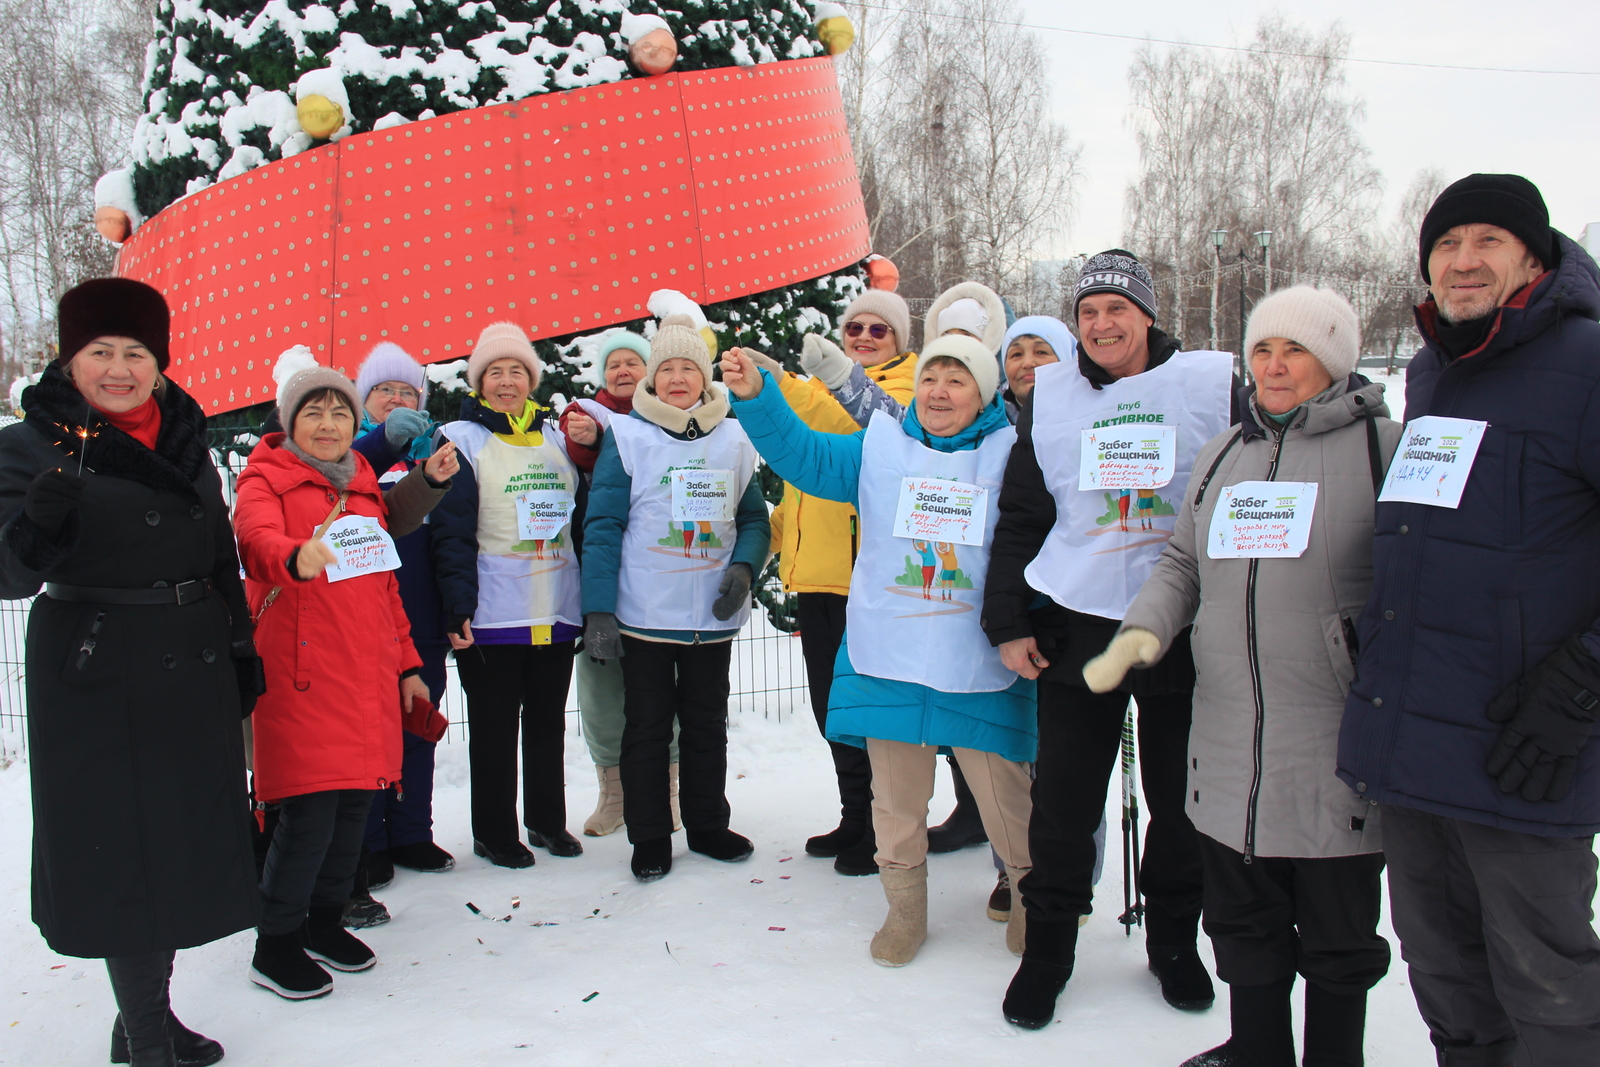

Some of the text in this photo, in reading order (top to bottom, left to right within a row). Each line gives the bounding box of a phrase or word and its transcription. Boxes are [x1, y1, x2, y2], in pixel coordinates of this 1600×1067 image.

[1118, 401, 1140, 411] Клуб
[1092, 414, 1164, 429] АКТИВНОЕ
[1098, 440, 1133, 450] Забег
[510, 473, 559, 482] АКТИВНОЕ
[505, 483, 566, 493] ДОЛГОЛЕТИЕ
[686, 482, 711, 490] Забег
[916, 492, 949, 504] Забег
[1230, 497, 1268, 508] Забег
[330, 528, 359, 540] Забег
